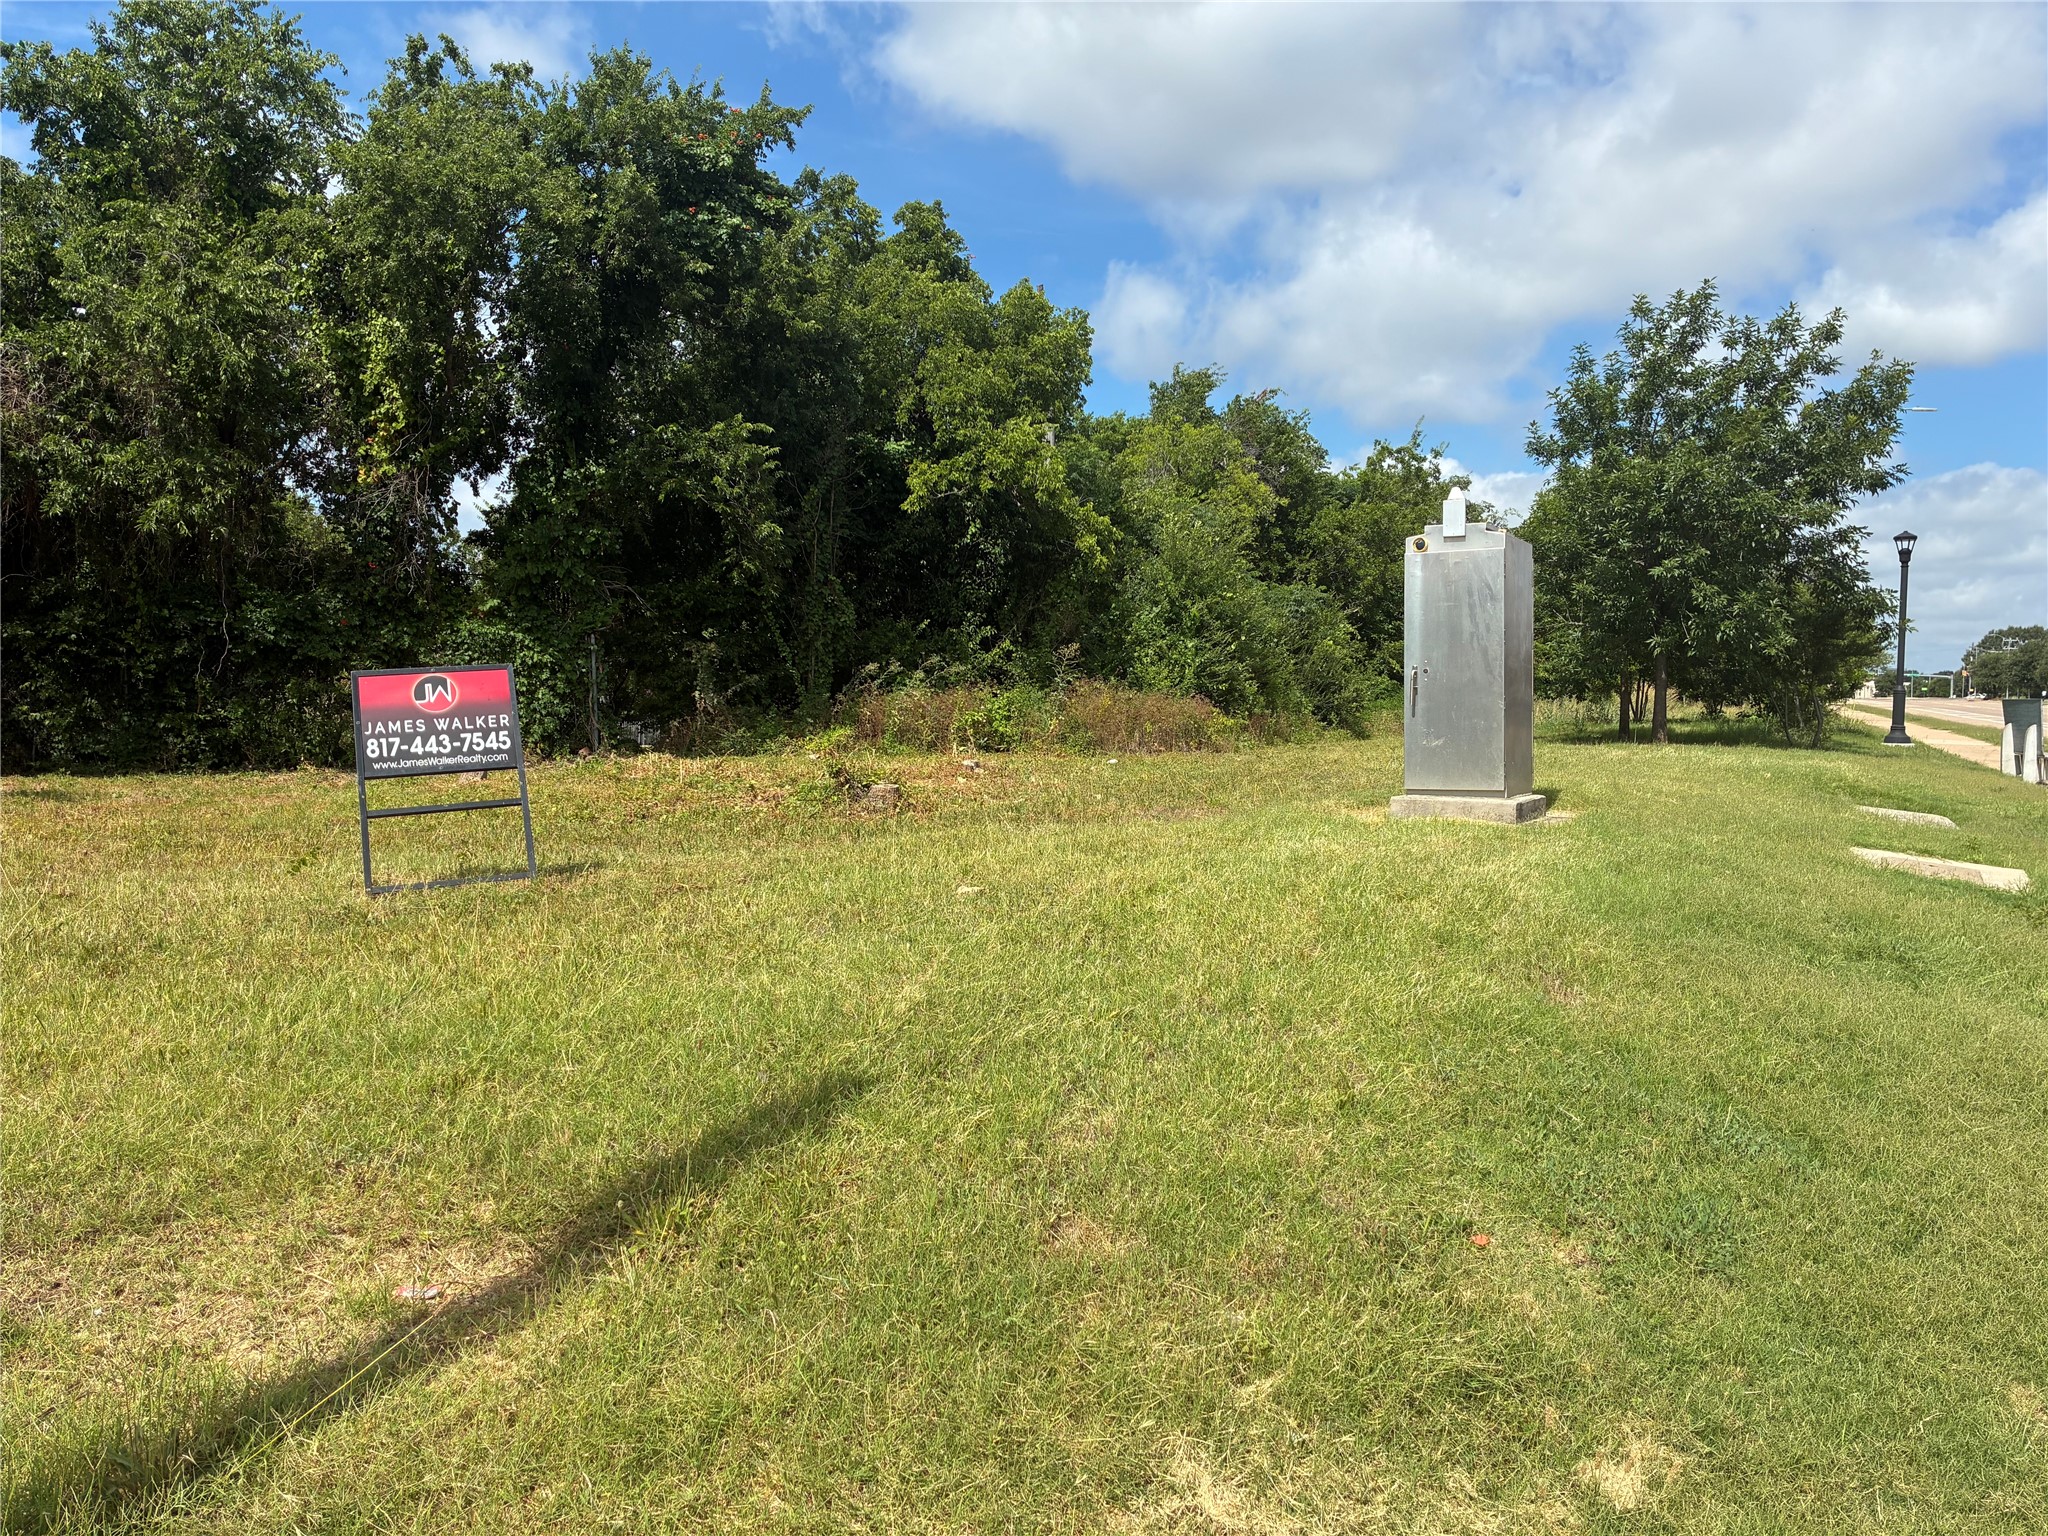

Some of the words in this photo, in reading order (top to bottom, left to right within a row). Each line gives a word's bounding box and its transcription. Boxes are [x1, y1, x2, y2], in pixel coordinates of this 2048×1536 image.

[416, 678, 452, 703] JW
[364, 719, 426, 735] JAMES
[433, 714, 510, 731] WALKER
[366, 731, 511, 758] 817-443-7545
[372, 753, 509, 770] www.JamesWalkerRealty.com
